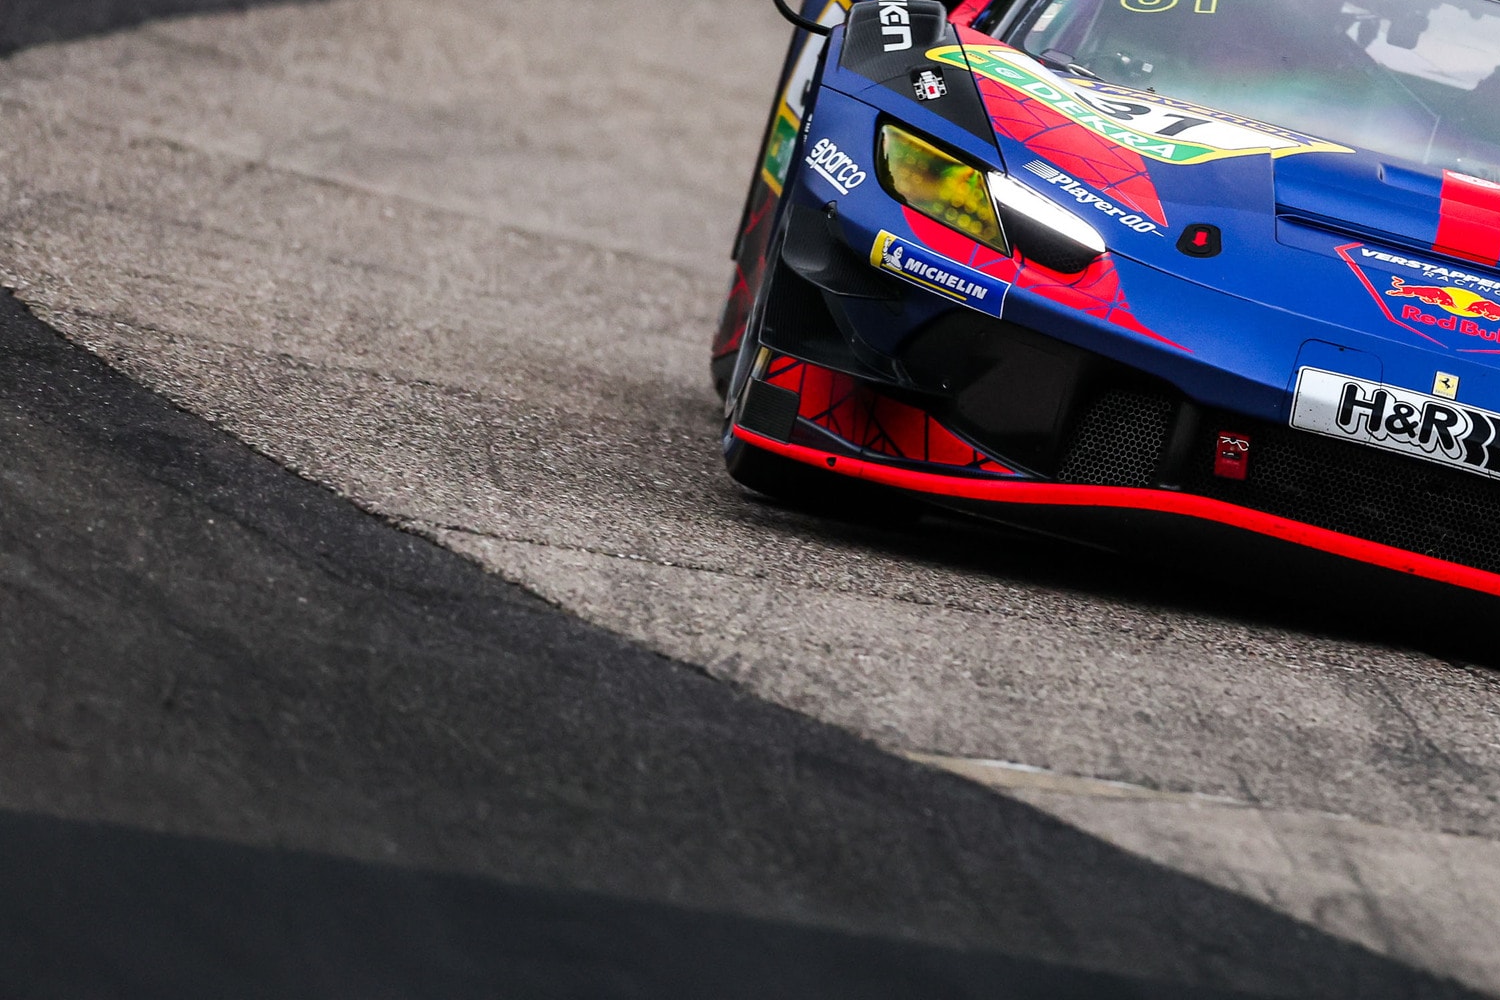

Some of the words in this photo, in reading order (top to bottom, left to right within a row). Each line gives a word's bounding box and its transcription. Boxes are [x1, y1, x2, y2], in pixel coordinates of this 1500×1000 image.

[1021, 82, 1179, 160] DEKRA
[1074, 91, 1212, 137] 31
[808, 138, 867, 193] sparco
[903, 257, 988, 300] MICHELIN
[1401, 304, 1458, 331] Red
[1335, 381, 1468, 458] H&R
